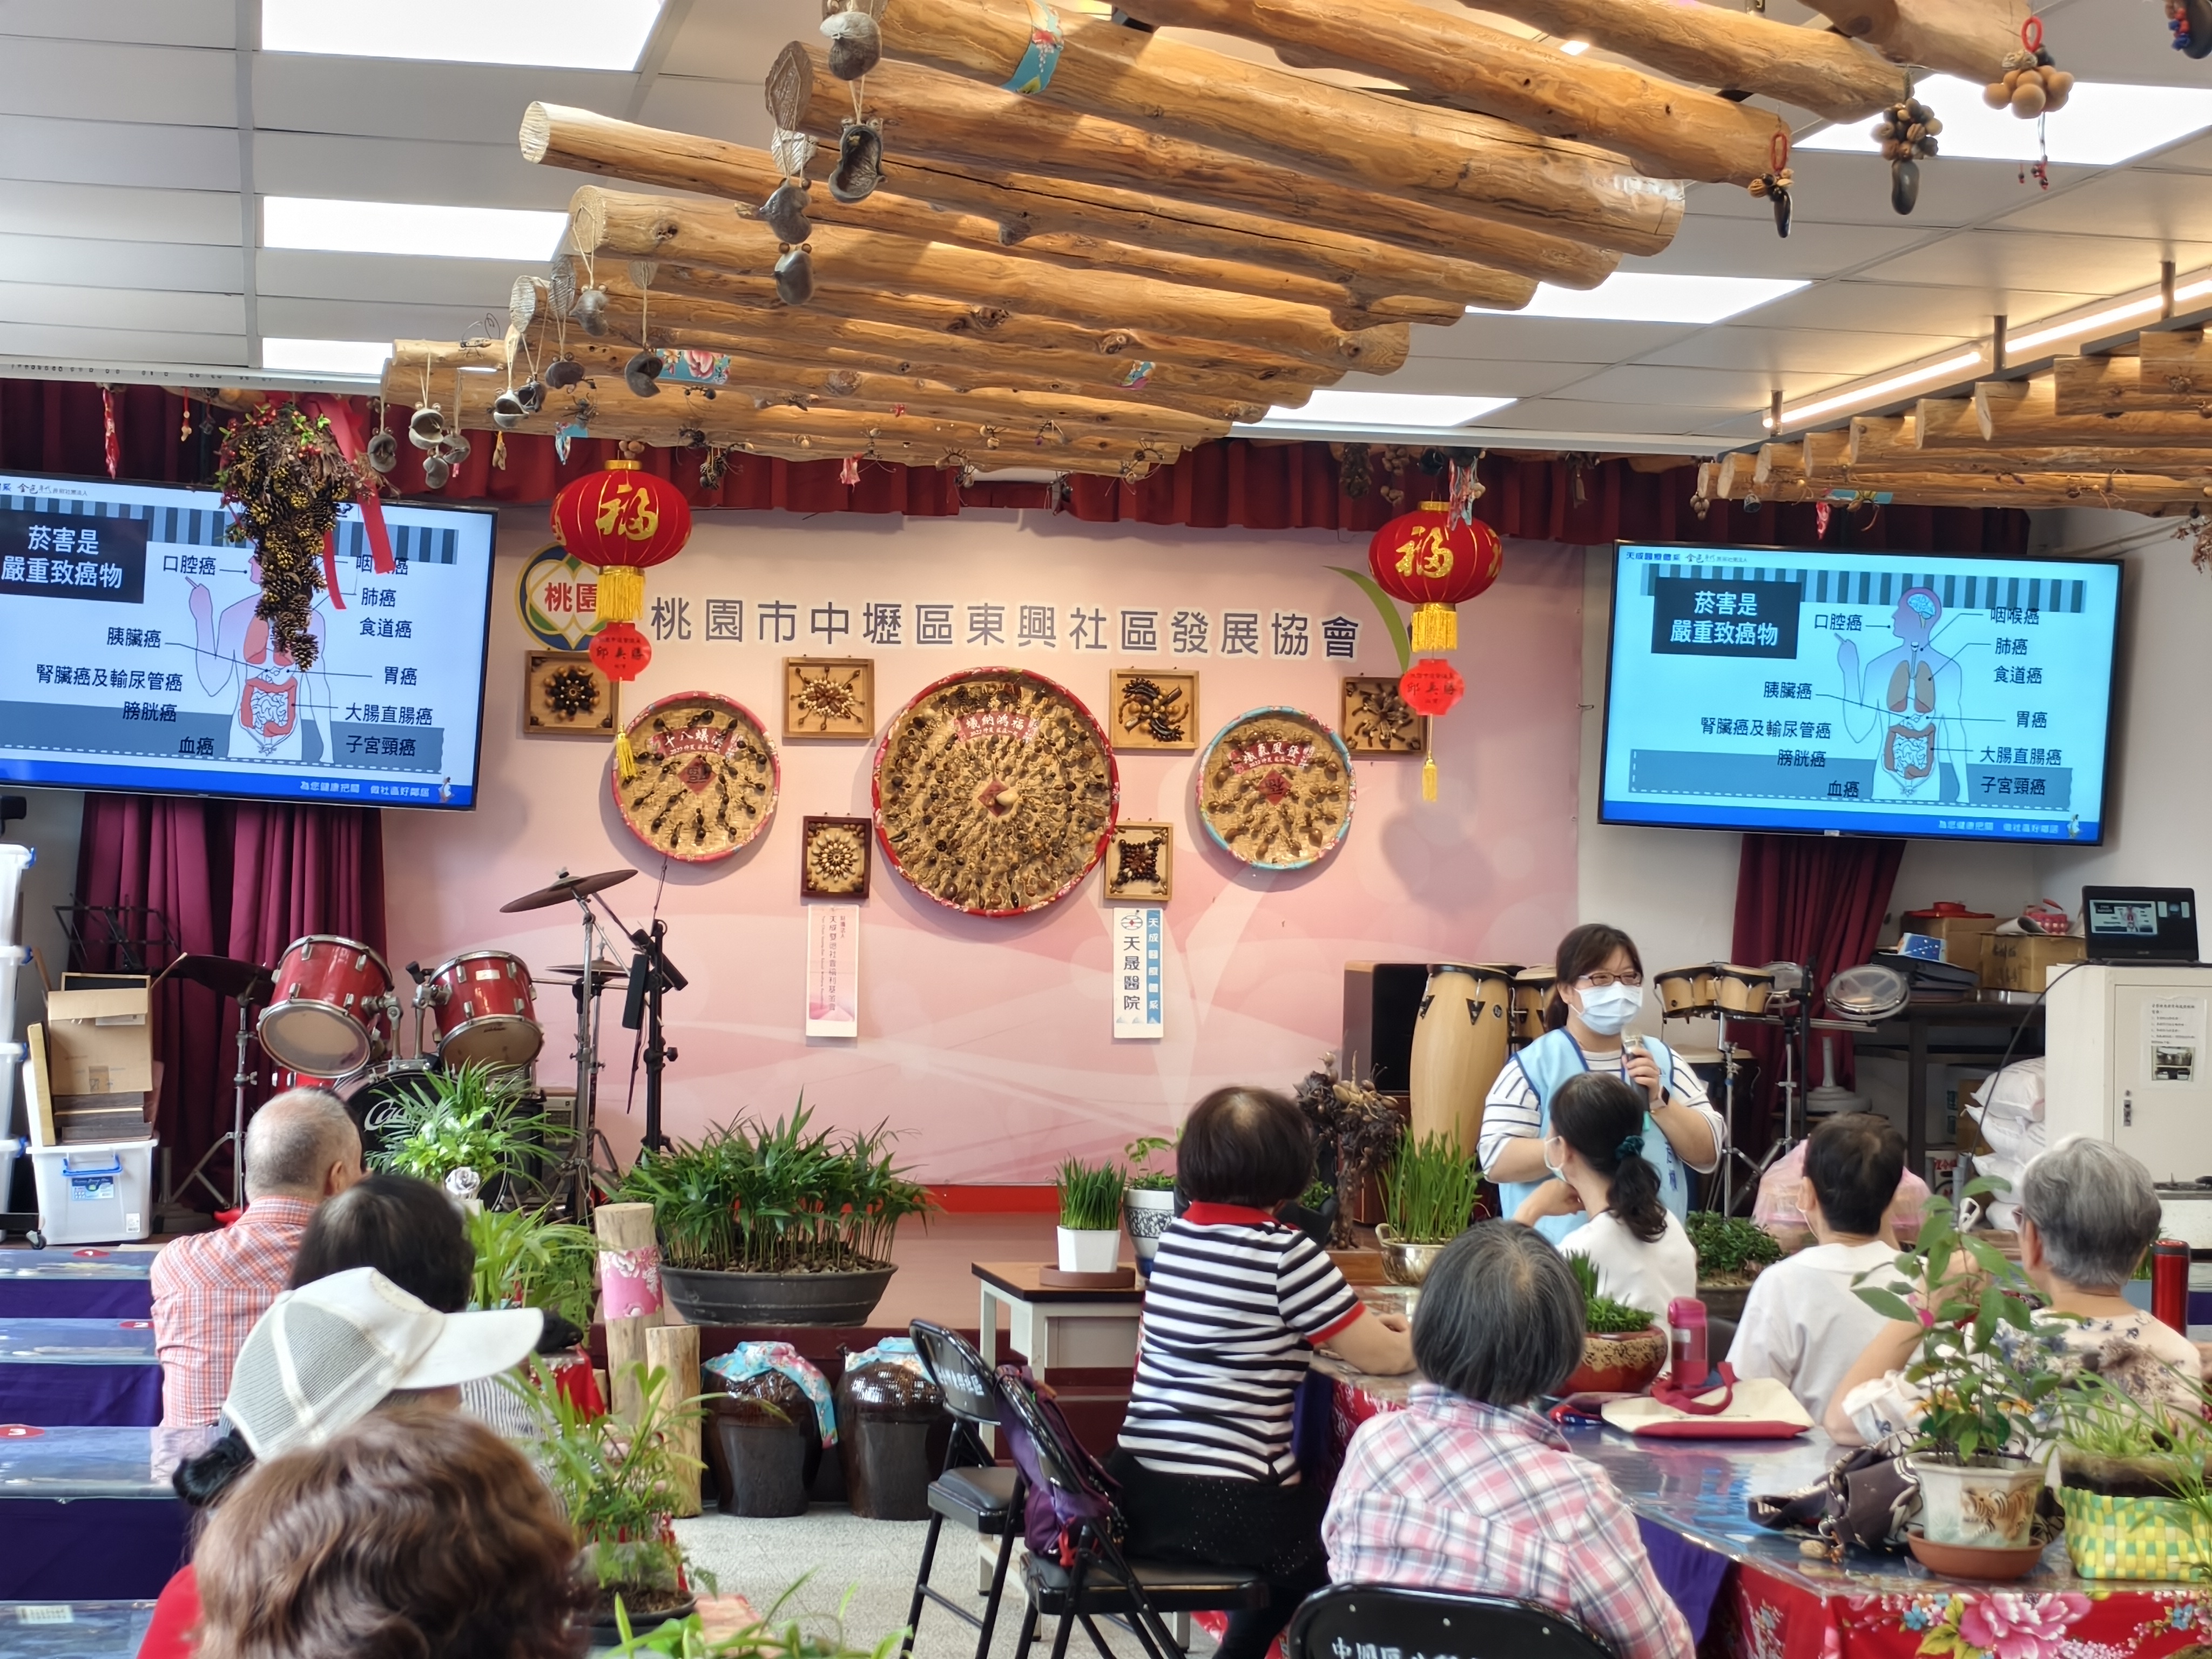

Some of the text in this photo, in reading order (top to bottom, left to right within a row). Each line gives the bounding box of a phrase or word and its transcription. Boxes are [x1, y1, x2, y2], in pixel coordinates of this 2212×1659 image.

[596, 482, 658, 541] 福
[28, 524, 99, 555] 菸害是
[1395, 525, 1454, 578] 福
[1, 555, 123, 589] 嚴重致癌物
[163, 554, 217, 577] 口腔癌
[356, 554, 409, 575] 咽癌
[361, 587, 396, 608] 肺癌
[544, 582, 598, 613] 桃園
[1694, 590, 1757, 617] 菸害是
[1814, 612, 1863, 632] 口腔癌
[1990, 606, 2040, 626] 咽喉癌
[107, 626, 161, 650] 胰臟癌
[360, 617, 413, 639] 食道癌
[651, 596, 1359, 659] 桃園市中壢區東興社區發展協會
[1670, 619, 1778, 648] 嚴重致癌物
[1995, 637, 2027, 656] 肺癌
[37, 663, 183, 693] 腎臟癌及輸尿管癌
[384, 666, 418, 687] 胃癌
[1993, 665, 2043, 685] 食道癌
[1764, 680, 1813, 700] 胰臟癌
[123, 700, 177, 723] 膀胱癌
[345, 702, 433, 726] 大腸直腸癌
[2016, 710, 2048, 729] 胃癌
[180, 736, 214, 757] 血癌
[346, 734, 416, 757] 子宮頸癌
[1980, 746, 2062, 767] 大腸直腸癌
[1778, 748, 1826, 768] 膀胱癌
[1827, 780, 1859, 799] 血癌
[1980, 775, 2046, 797] 子宮頸癌
[1123, 936, 1140, 1010] 天晟醫院
